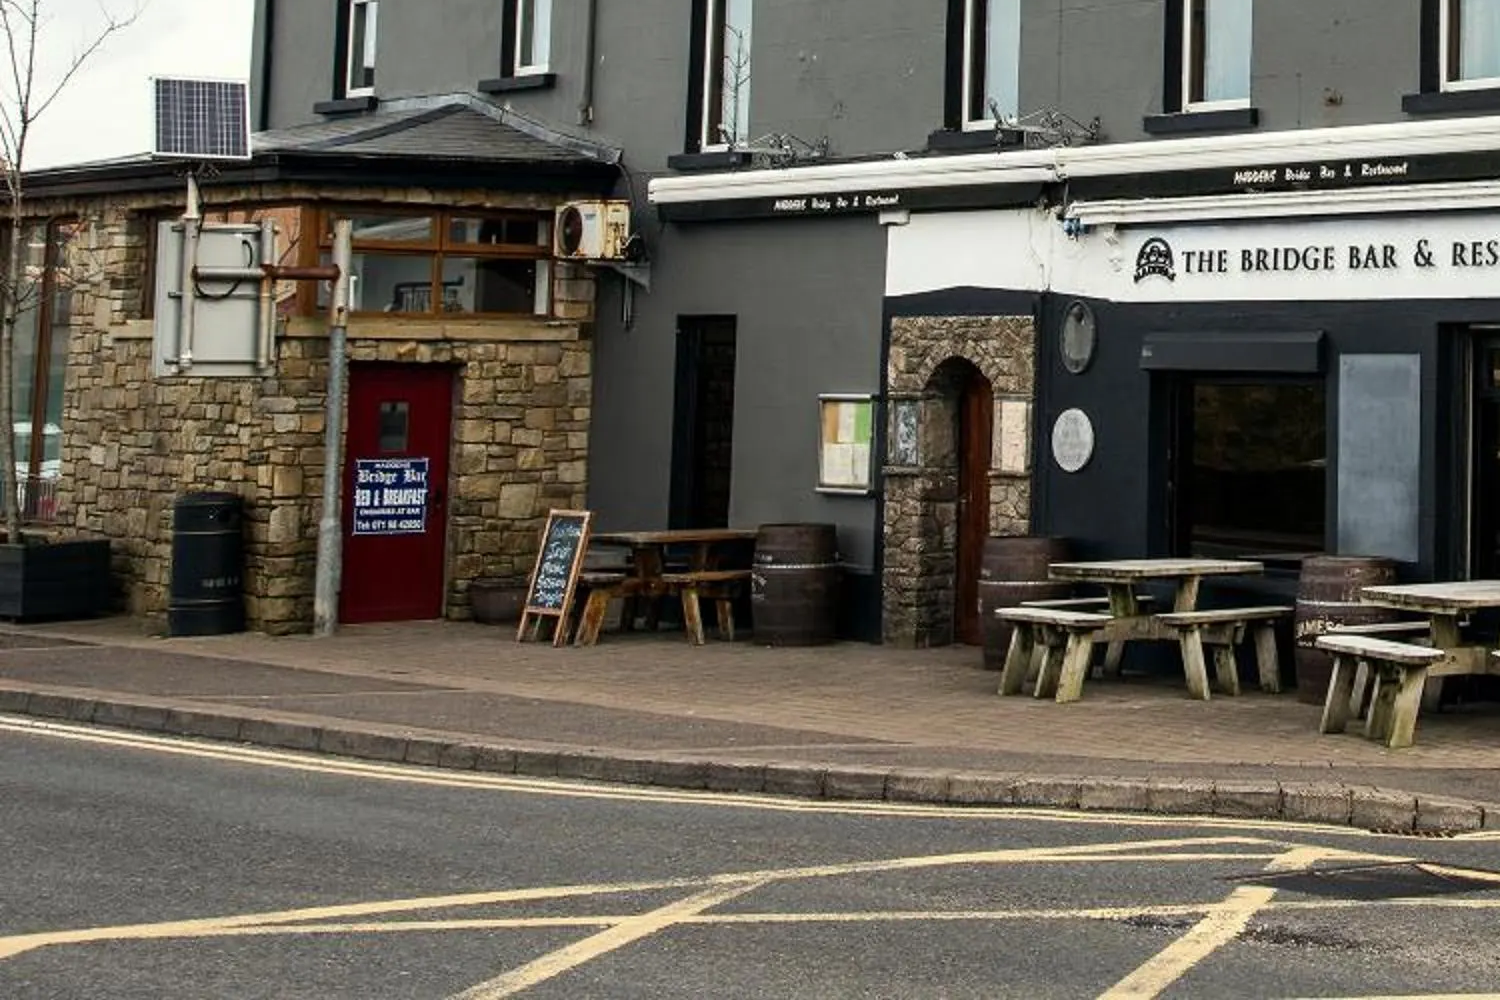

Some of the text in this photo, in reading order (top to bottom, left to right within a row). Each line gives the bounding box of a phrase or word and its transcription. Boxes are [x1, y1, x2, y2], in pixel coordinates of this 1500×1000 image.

[1182, 250, 1228, 273] THE
[1241, 245, 1335, 272] BRIDGE
[1349, 243, 1398, 270] BAR
[1413, 238, 1435, 268] &
[358, 469, 427, 485] Bridge Bar
[354, 487, 428, 507] BED & BREAKFAST
